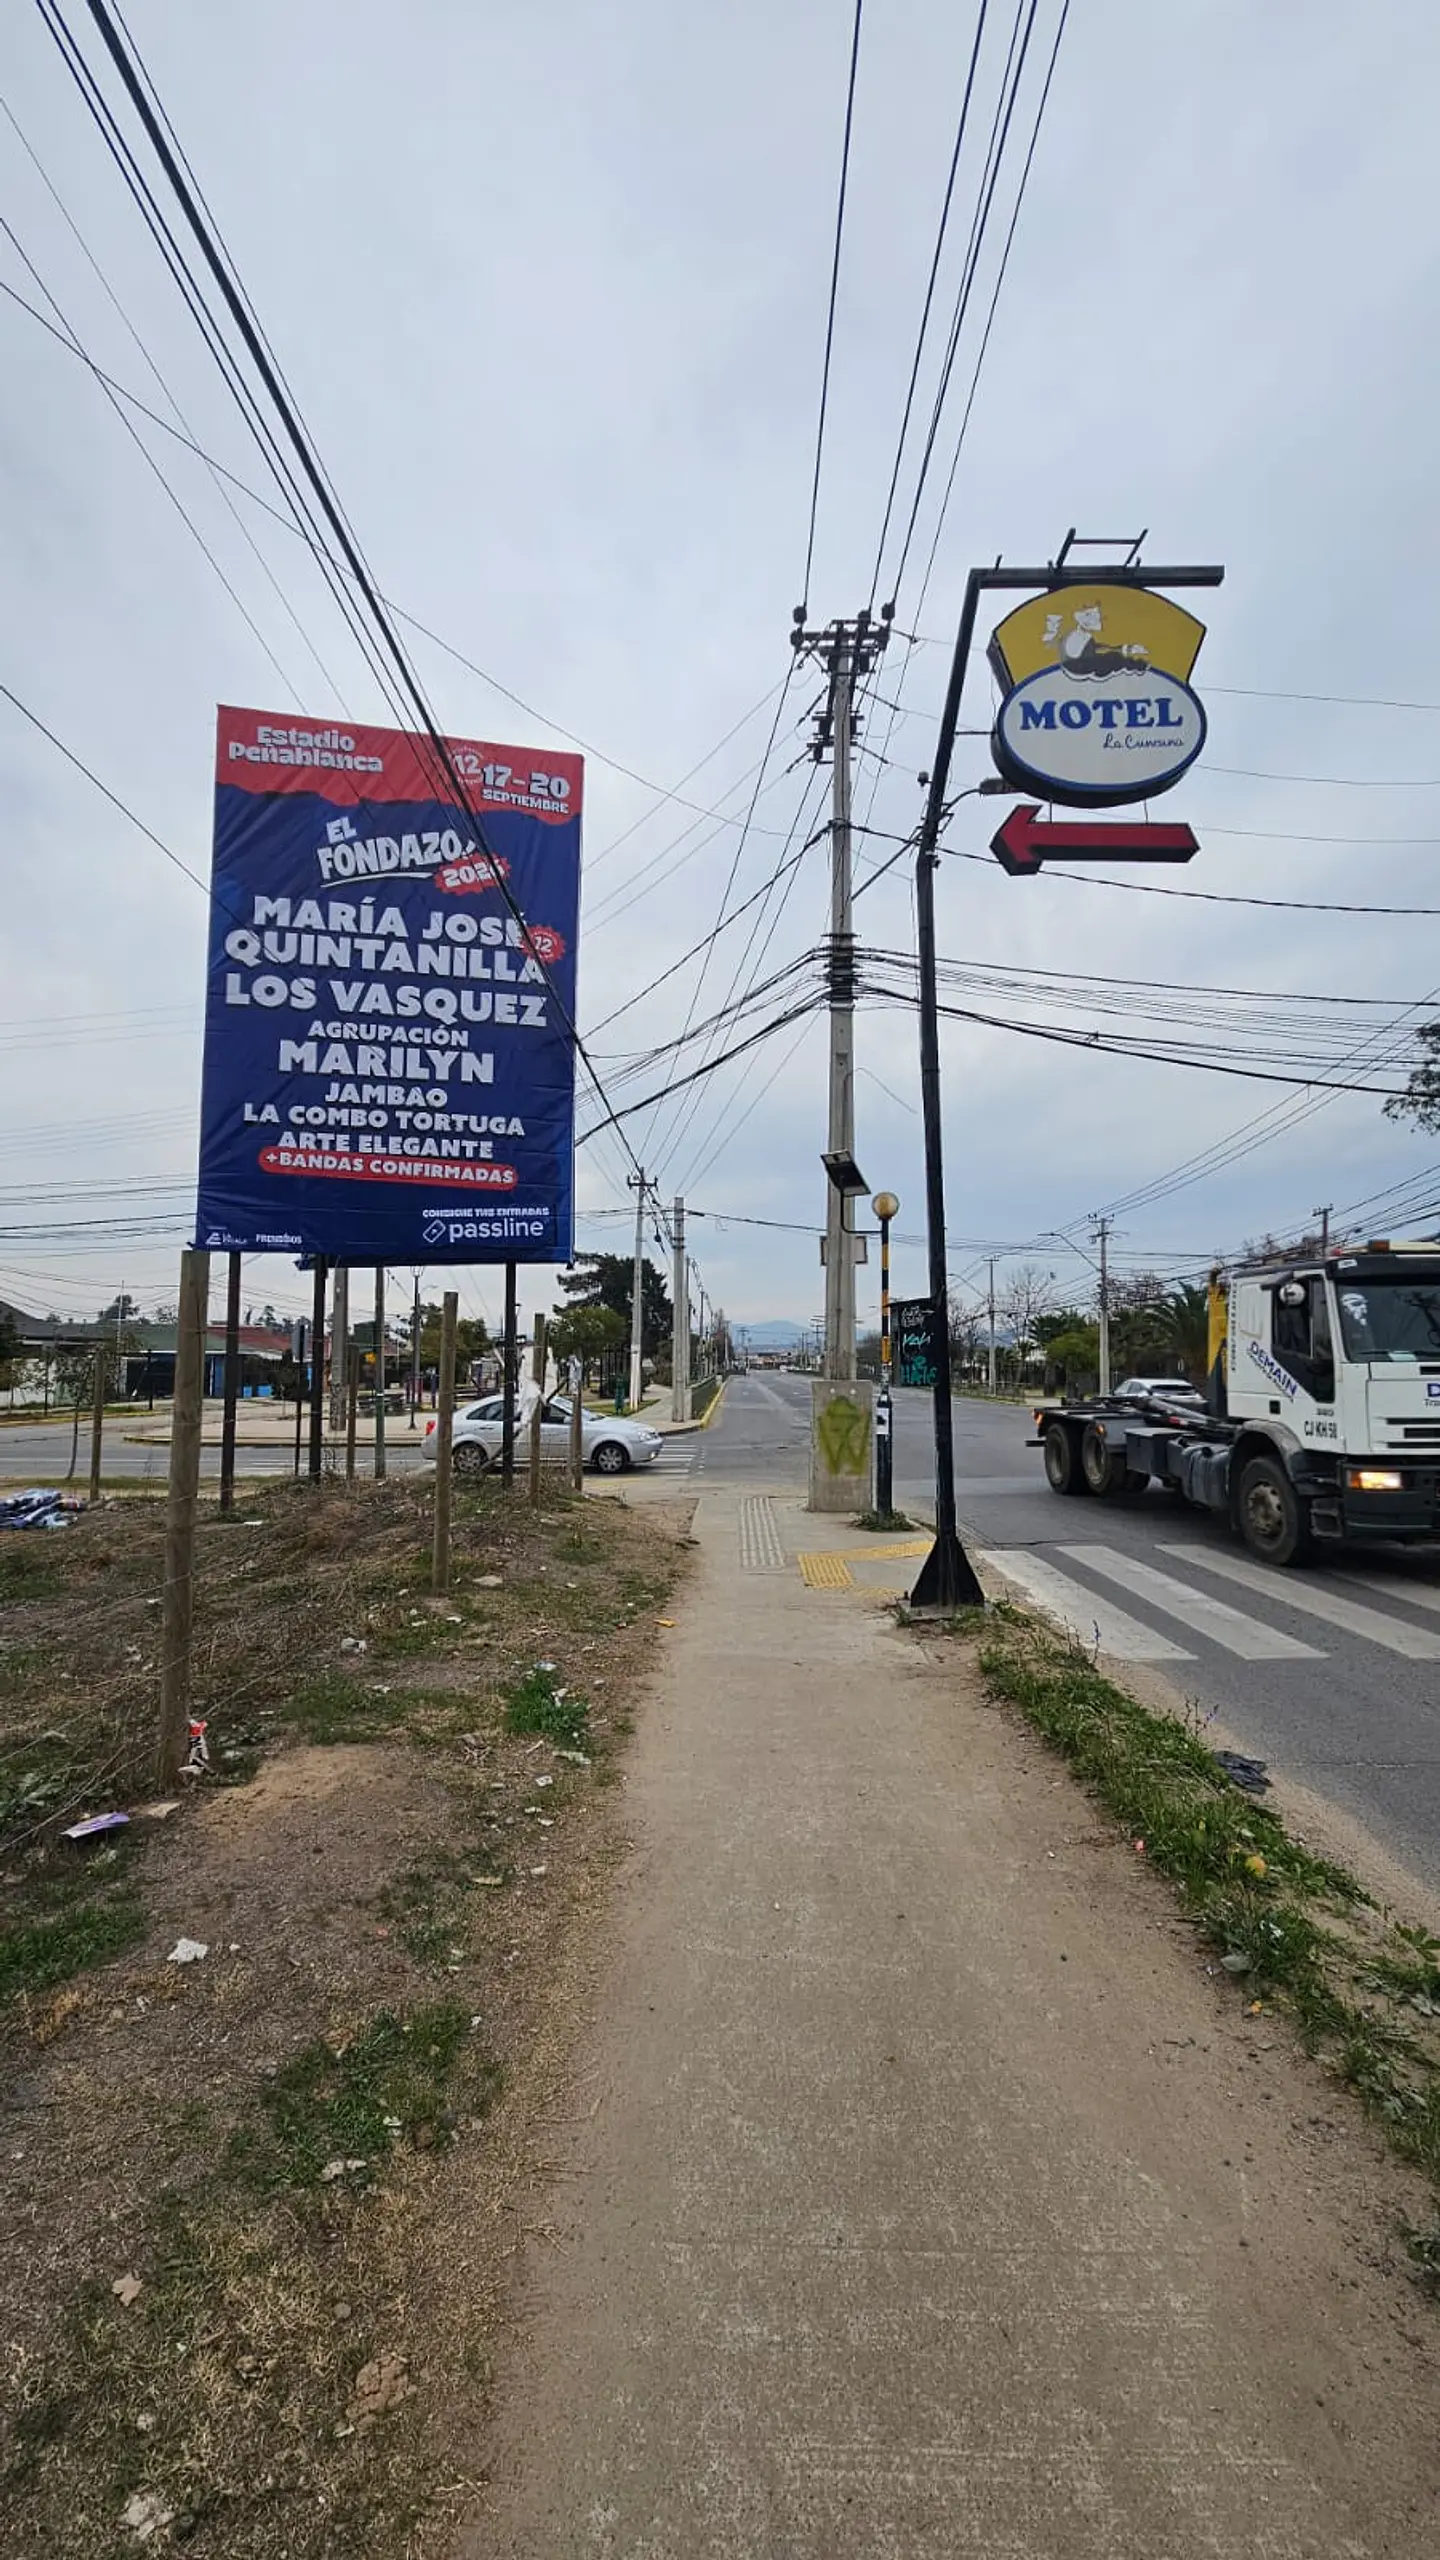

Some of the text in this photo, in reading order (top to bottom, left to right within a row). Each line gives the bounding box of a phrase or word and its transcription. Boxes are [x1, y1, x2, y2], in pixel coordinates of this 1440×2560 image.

[1019, 698, 1184, 731] MOTEL
[256, 725, 356, 753] Estadio
[1103, 732, 1122, 749] La
[228, 742, 384, 774] Peñablanca
[482, 788, 570, 814] SEPTIEMBRE
[326, 816, 357, 844] EL
[253, 895, 408, 938] MARÍA
[224, 929, 547, 985] QUINTANILLA
[226, 973, 547, 1027] LOS VASQUEZ
[307, 1020, 469, 1048] AGRUPACIÓN
[278, 1039, 495, 1084] MARILYN
[324, 1082, 448, 1109] JAMBAO
[243, 1102, 526, 1137] LA COMBO TORTUGA
[277, 1131, 494, 1160] ARTE ELEGANTE
[264, 1151, 515, 1185] +BANDAS CONFIRMADAS
[448, 1217, 545, 1243] passline
[1250, 1341, 1298, 1396] DEMAIN
